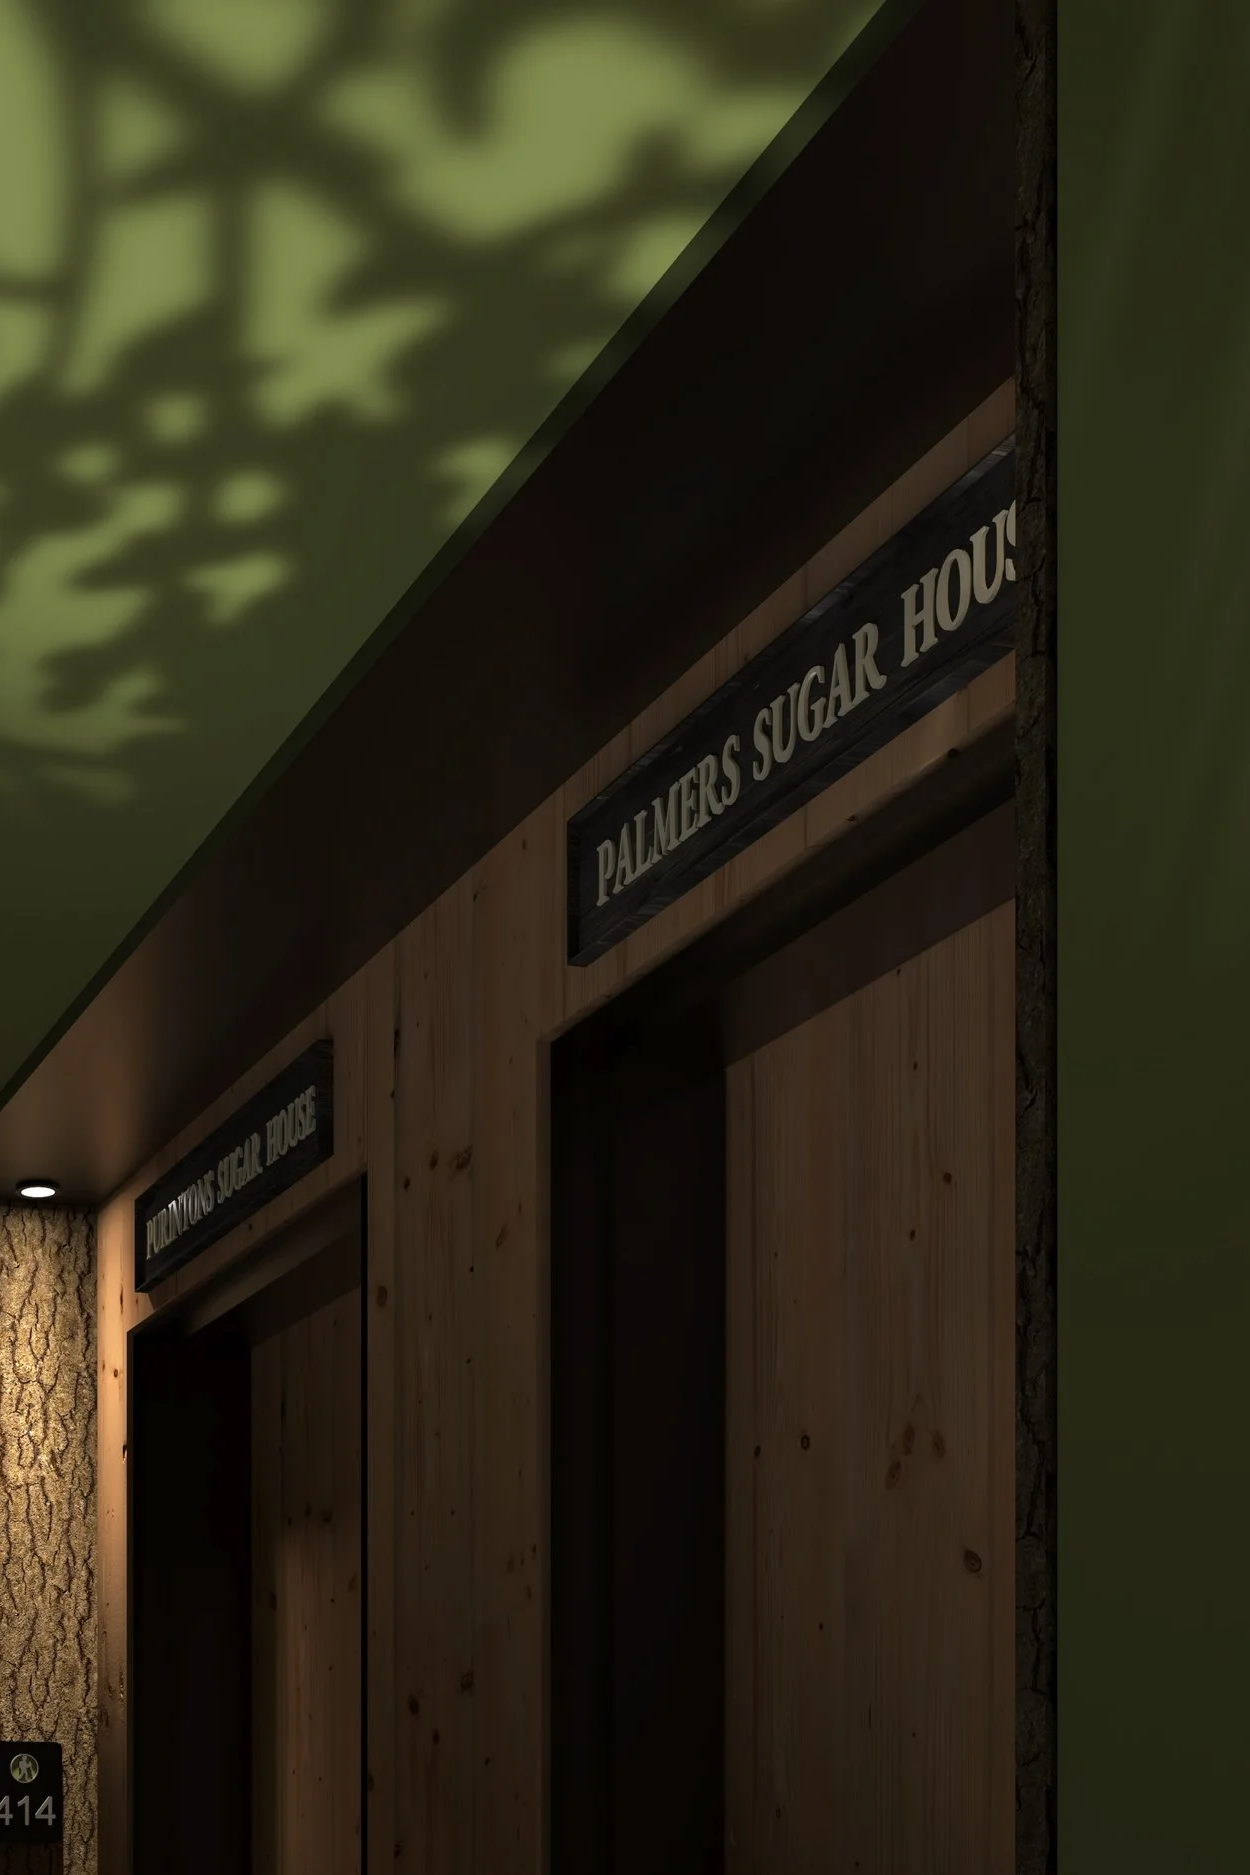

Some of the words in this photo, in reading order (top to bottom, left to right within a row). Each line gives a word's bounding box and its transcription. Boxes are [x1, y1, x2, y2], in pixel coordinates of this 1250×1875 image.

[595, 734, 741, 906] PALMERS
[752, 621, 888, 782] SUGAR
[217, 1131, 264, 1204] SUGAR
[265, 1084, 317, 1167] HOUSE
